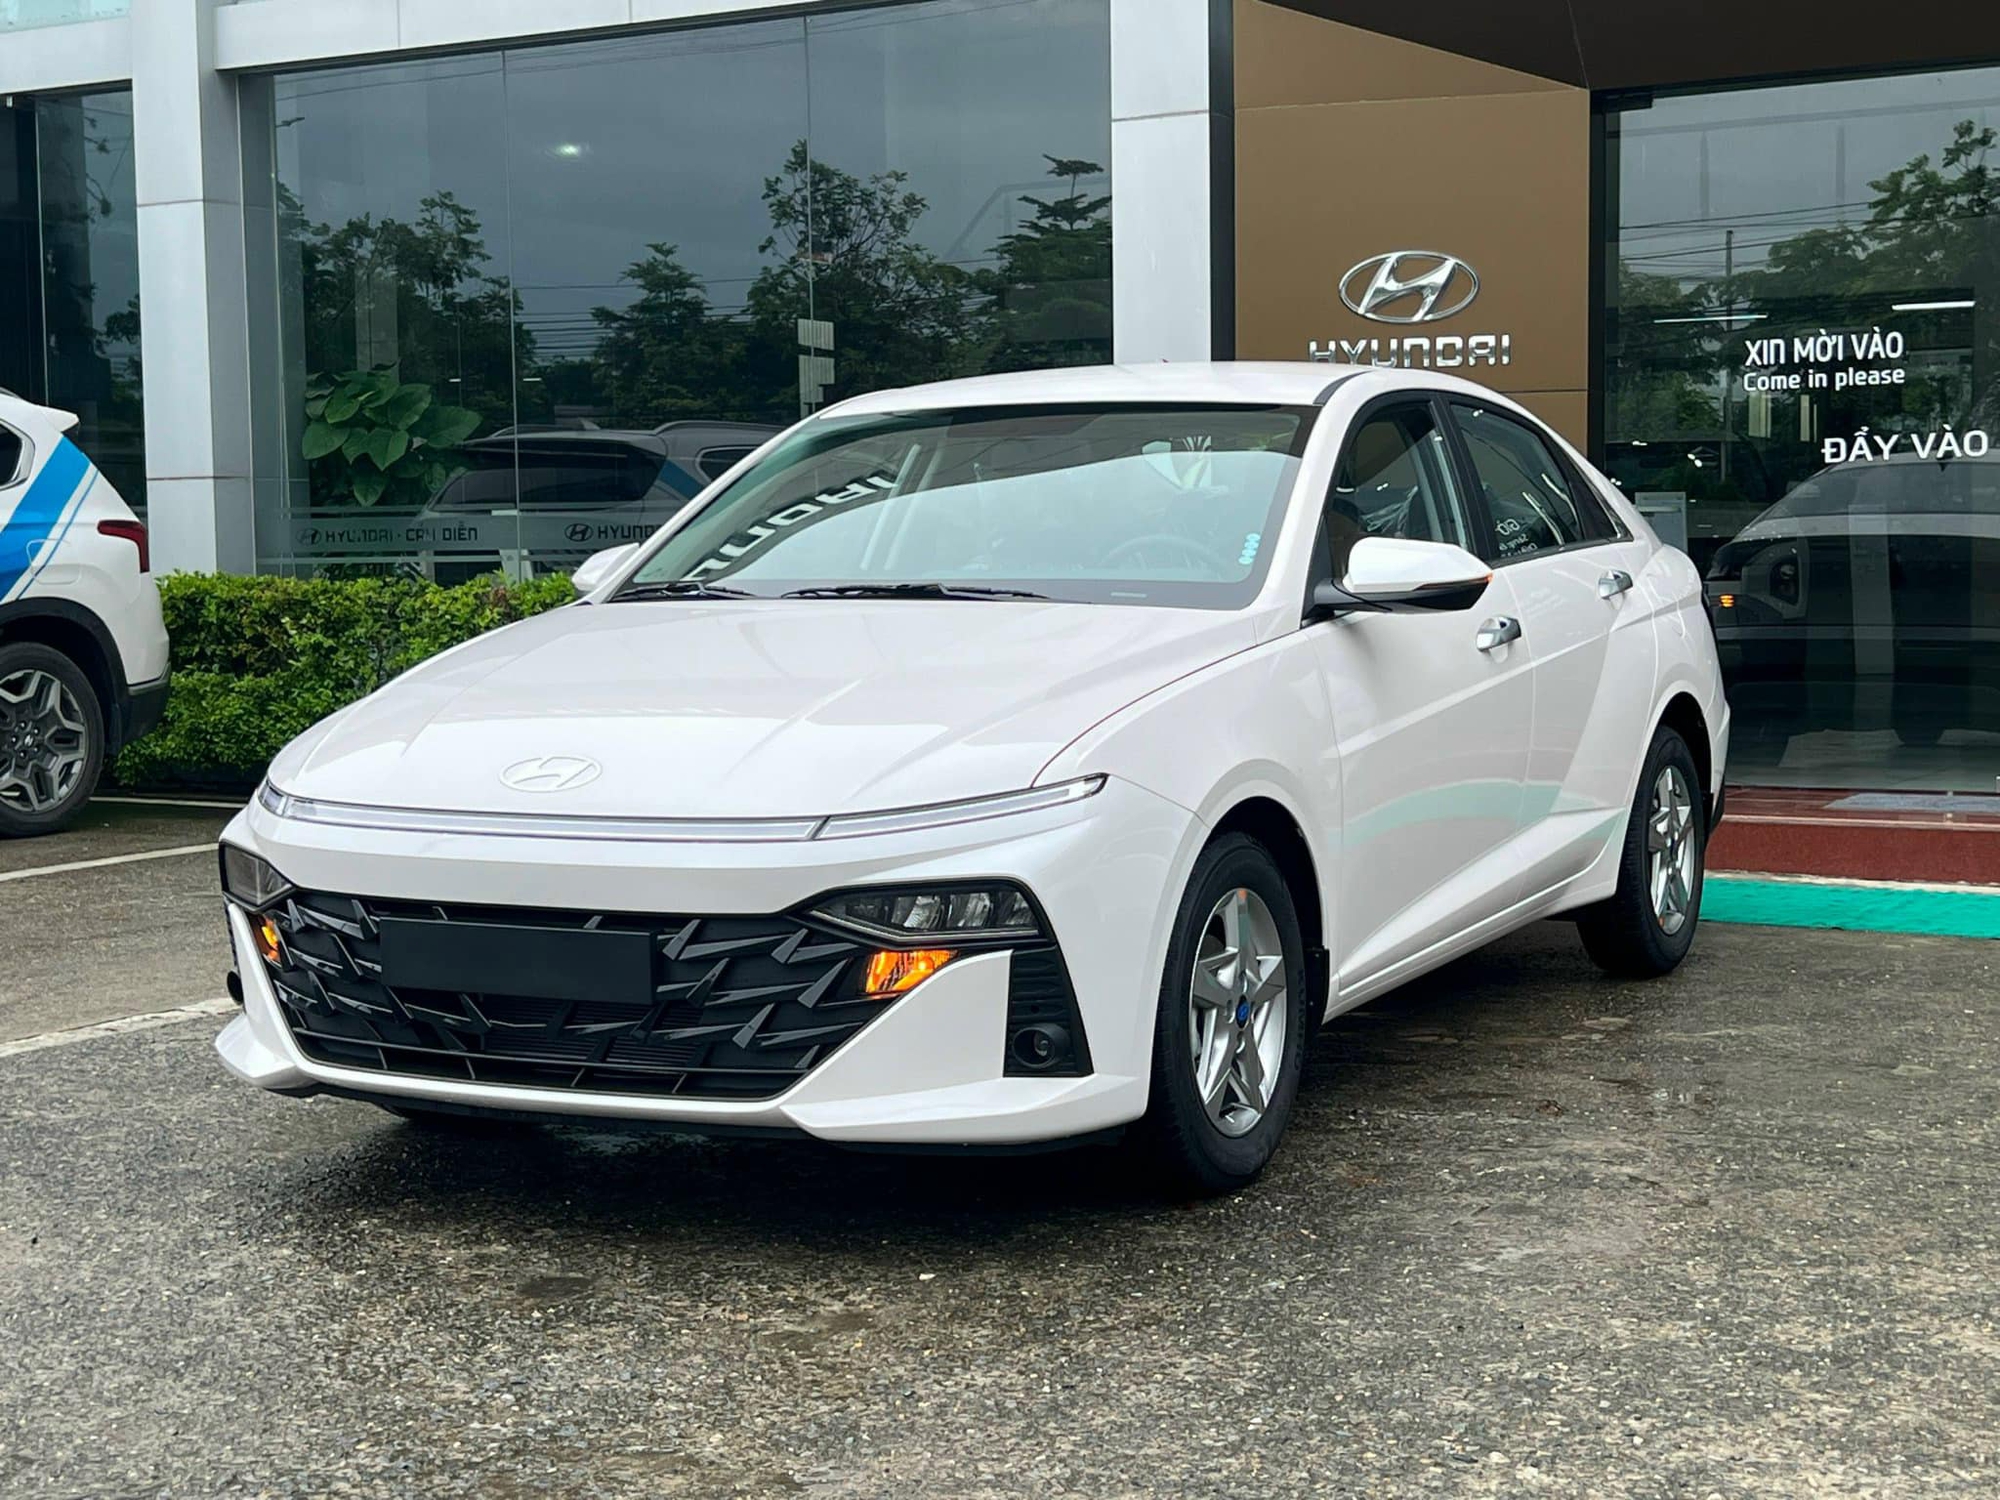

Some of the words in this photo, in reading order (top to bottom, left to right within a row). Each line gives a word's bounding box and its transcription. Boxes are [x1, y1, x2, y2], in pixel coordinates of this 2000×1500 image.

[1309, 335, 1510, 368] HYUNDAI
[1745, 339, 1785, 366] XIN
[1793, 328, 1844, 363] MỜI
[1851, 326, 1903, 360] VÀO
[1743, 373, 1801, 391] Come
[1808, 369, 1828, 388] in
[1835, 367, 1905, 391] please
[1821, 426, 1899, 464] ĐẨY
[1910, 424, 1989, 459] VÀO
